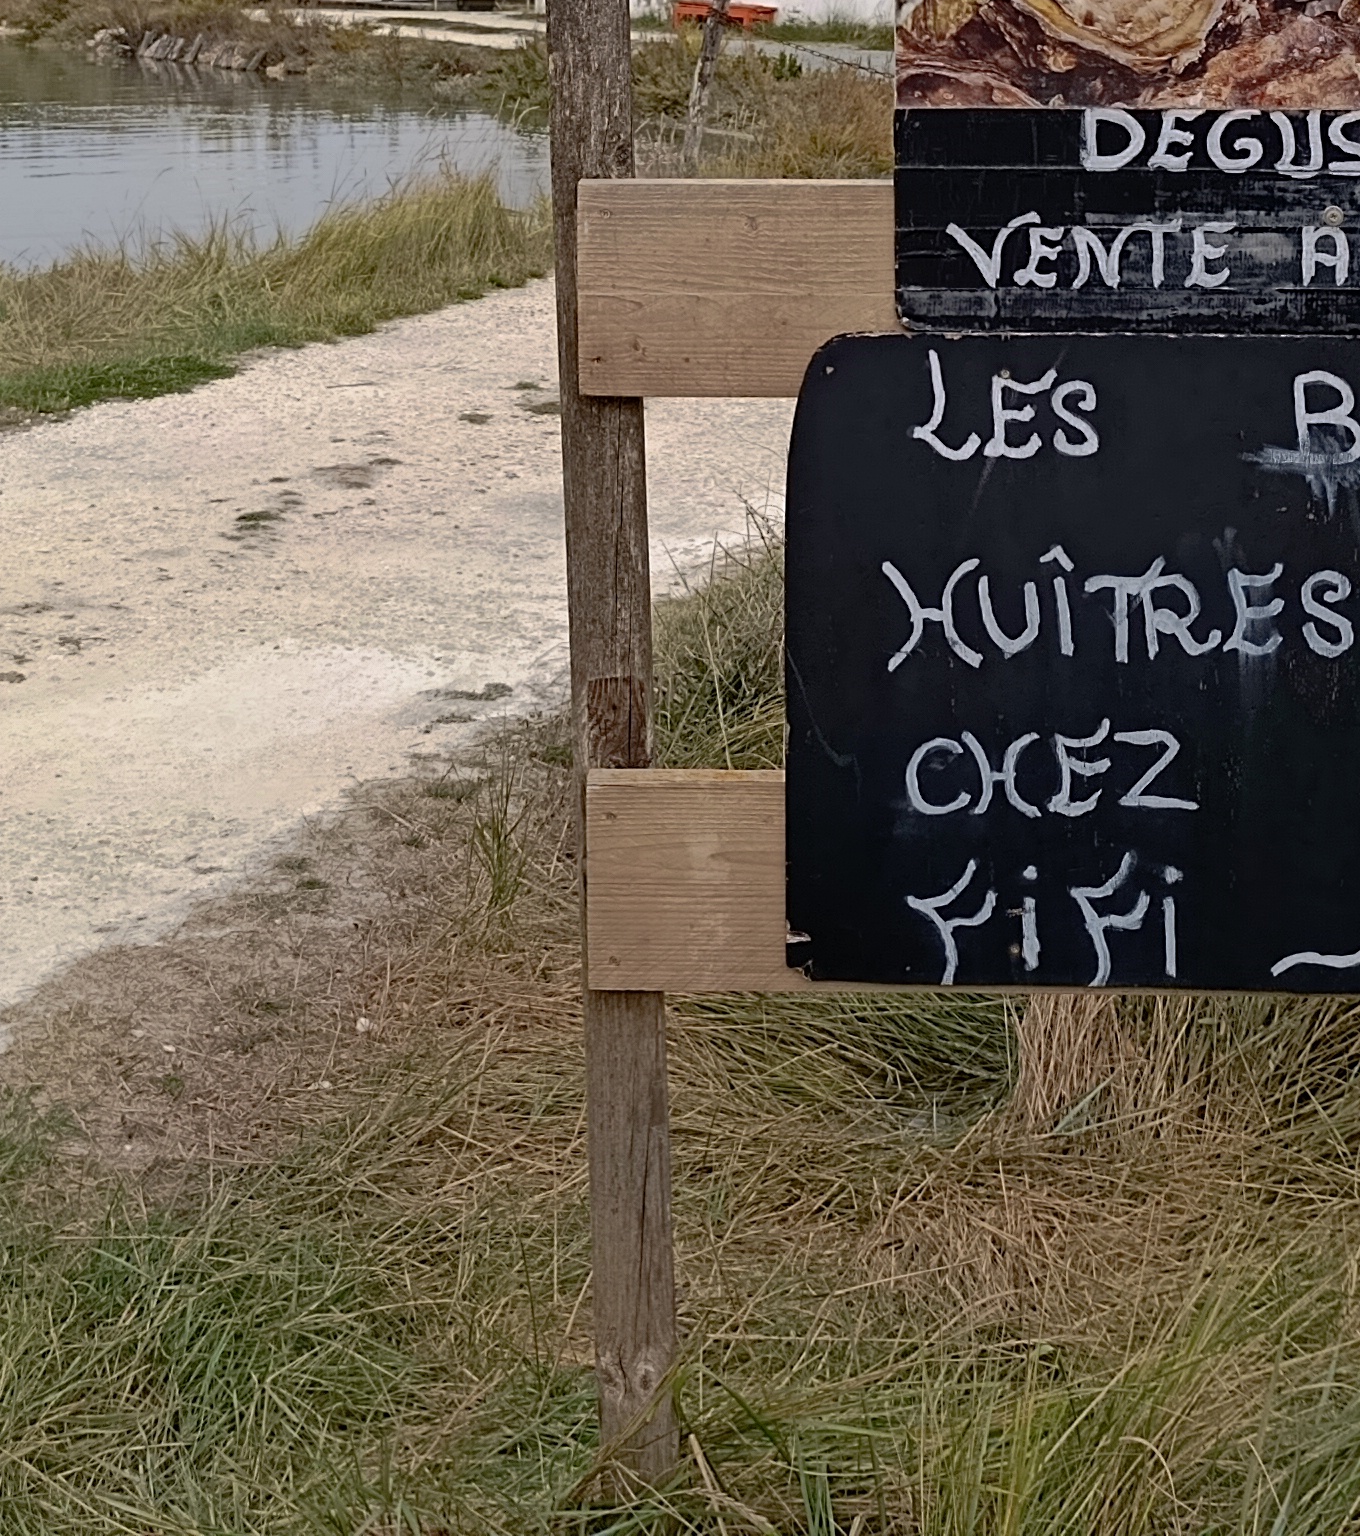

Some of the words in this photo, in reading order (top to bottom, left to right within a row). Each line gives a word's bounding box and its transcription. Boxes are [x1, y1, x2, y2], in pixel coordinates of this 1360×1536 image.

[947, 212, 1236, 288] VENTE
[1302, 225, 1349, 286] A
[914, 350, 1098, 460] LES
[882, 546, 1352, 671] HUÎTRES
[906, 718, 1198, 816] CHEZ
